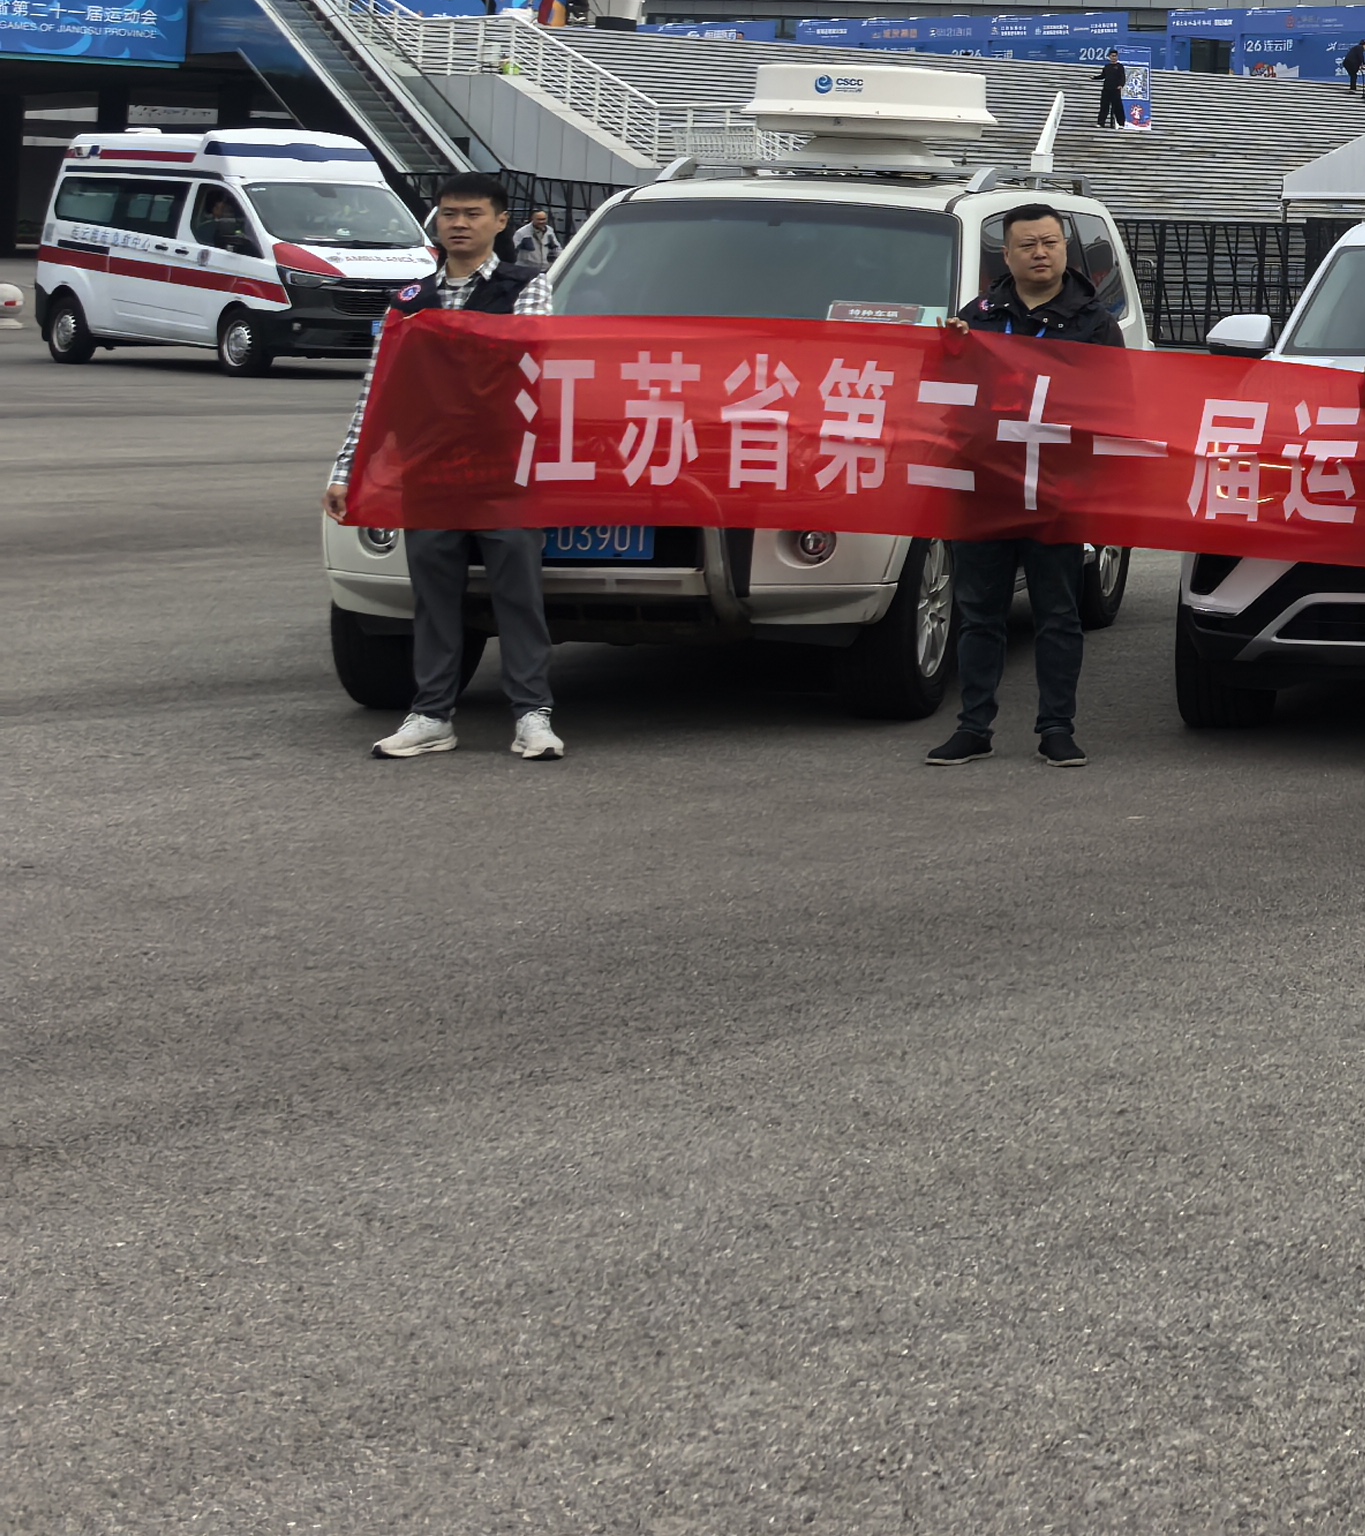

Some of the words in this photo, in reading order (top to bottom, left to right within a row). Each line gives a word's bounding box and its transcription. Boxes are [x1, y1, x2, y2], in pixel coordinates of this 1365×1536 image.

[40, 23, 55, 32] OF
[57, 24, 101, 36] JIANGSU
[105, 27, 157, 39] PROVINCE
[1263, 39, 1293, 52] 连云港
